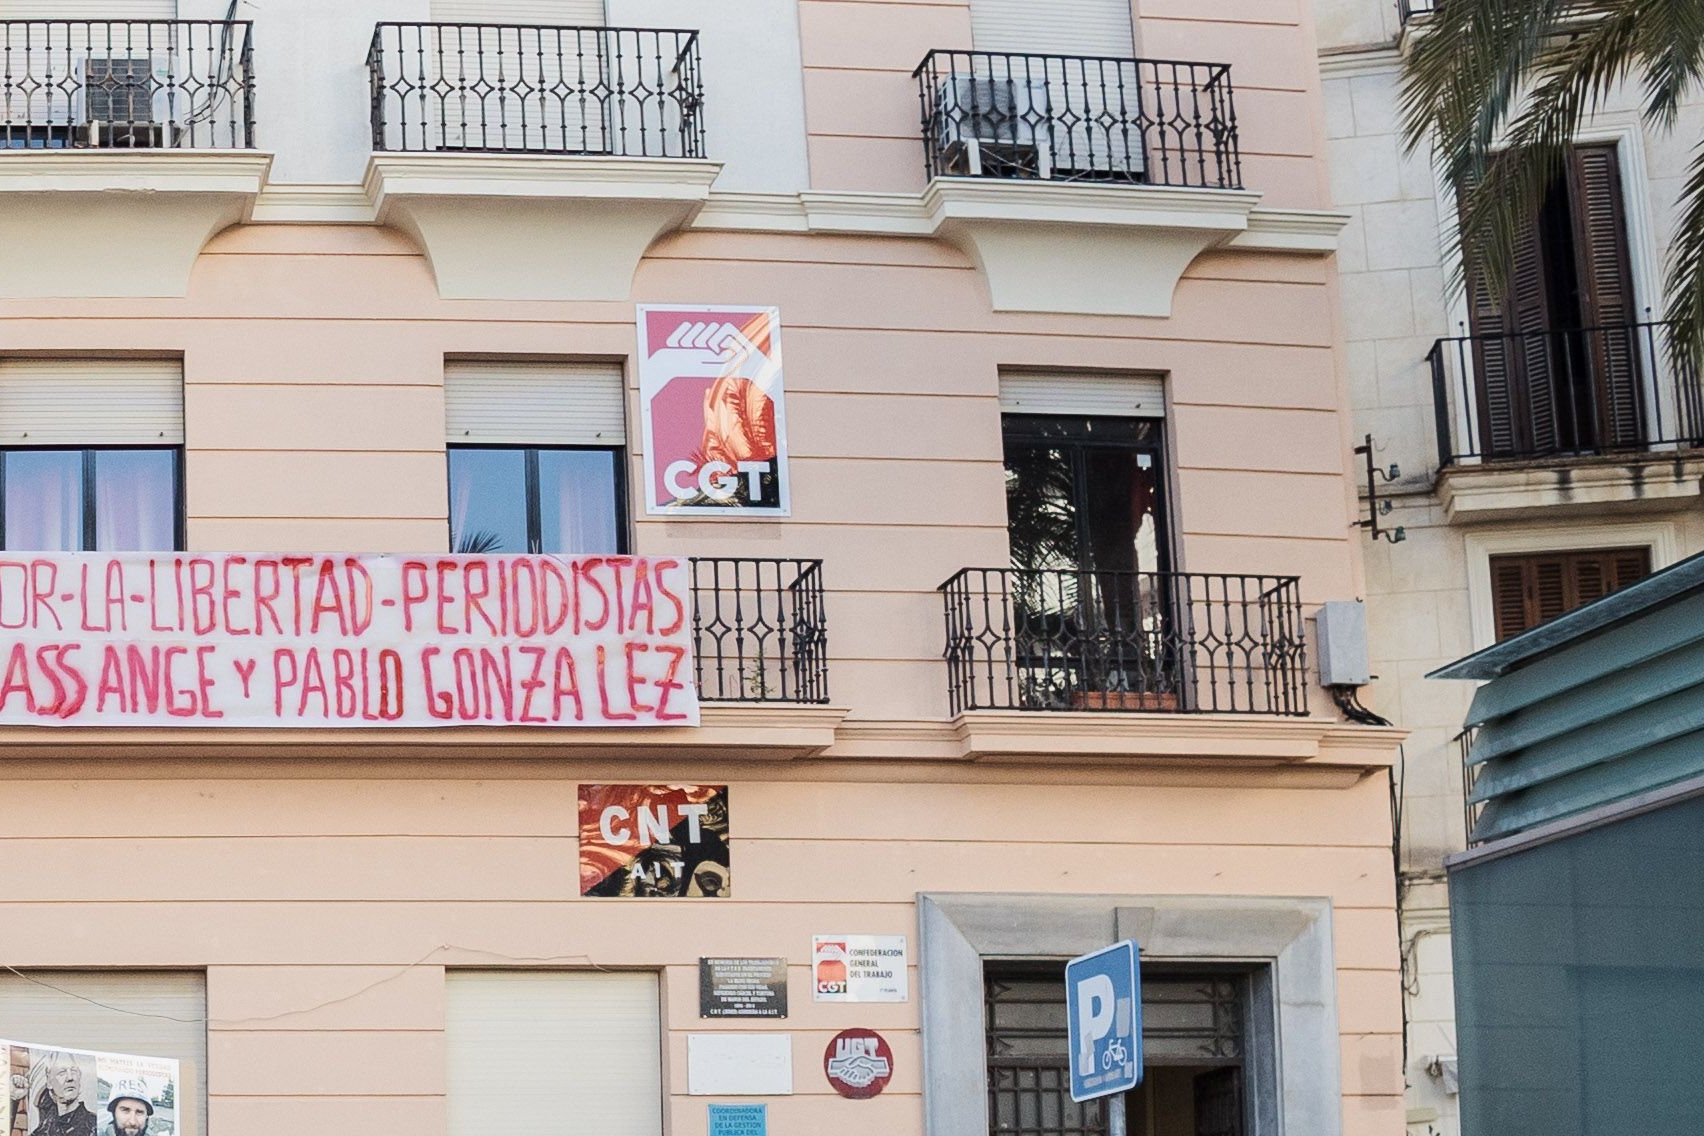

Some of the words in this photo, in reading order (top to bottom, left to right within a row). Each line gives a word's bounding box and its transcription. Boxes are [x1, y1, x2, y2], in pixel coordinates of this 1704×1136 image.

[663, 459, 770, 501] CGT
[234, 657, 256, 699] Y
[273, 648, 403, 720] PABLO
[599, 803, 708, 846] CNT
[631, 861, 685, 879] AIT
[849, 959, 879, 968] GENERAL
[850, 970, 861, 979] DEL
[863, 970, 893, 979] TRABAJO
[818, 980, 846, 994] CGT
[1077, 974, 1115, 1077] P
[836, 1037, 879, 1058] UGT
